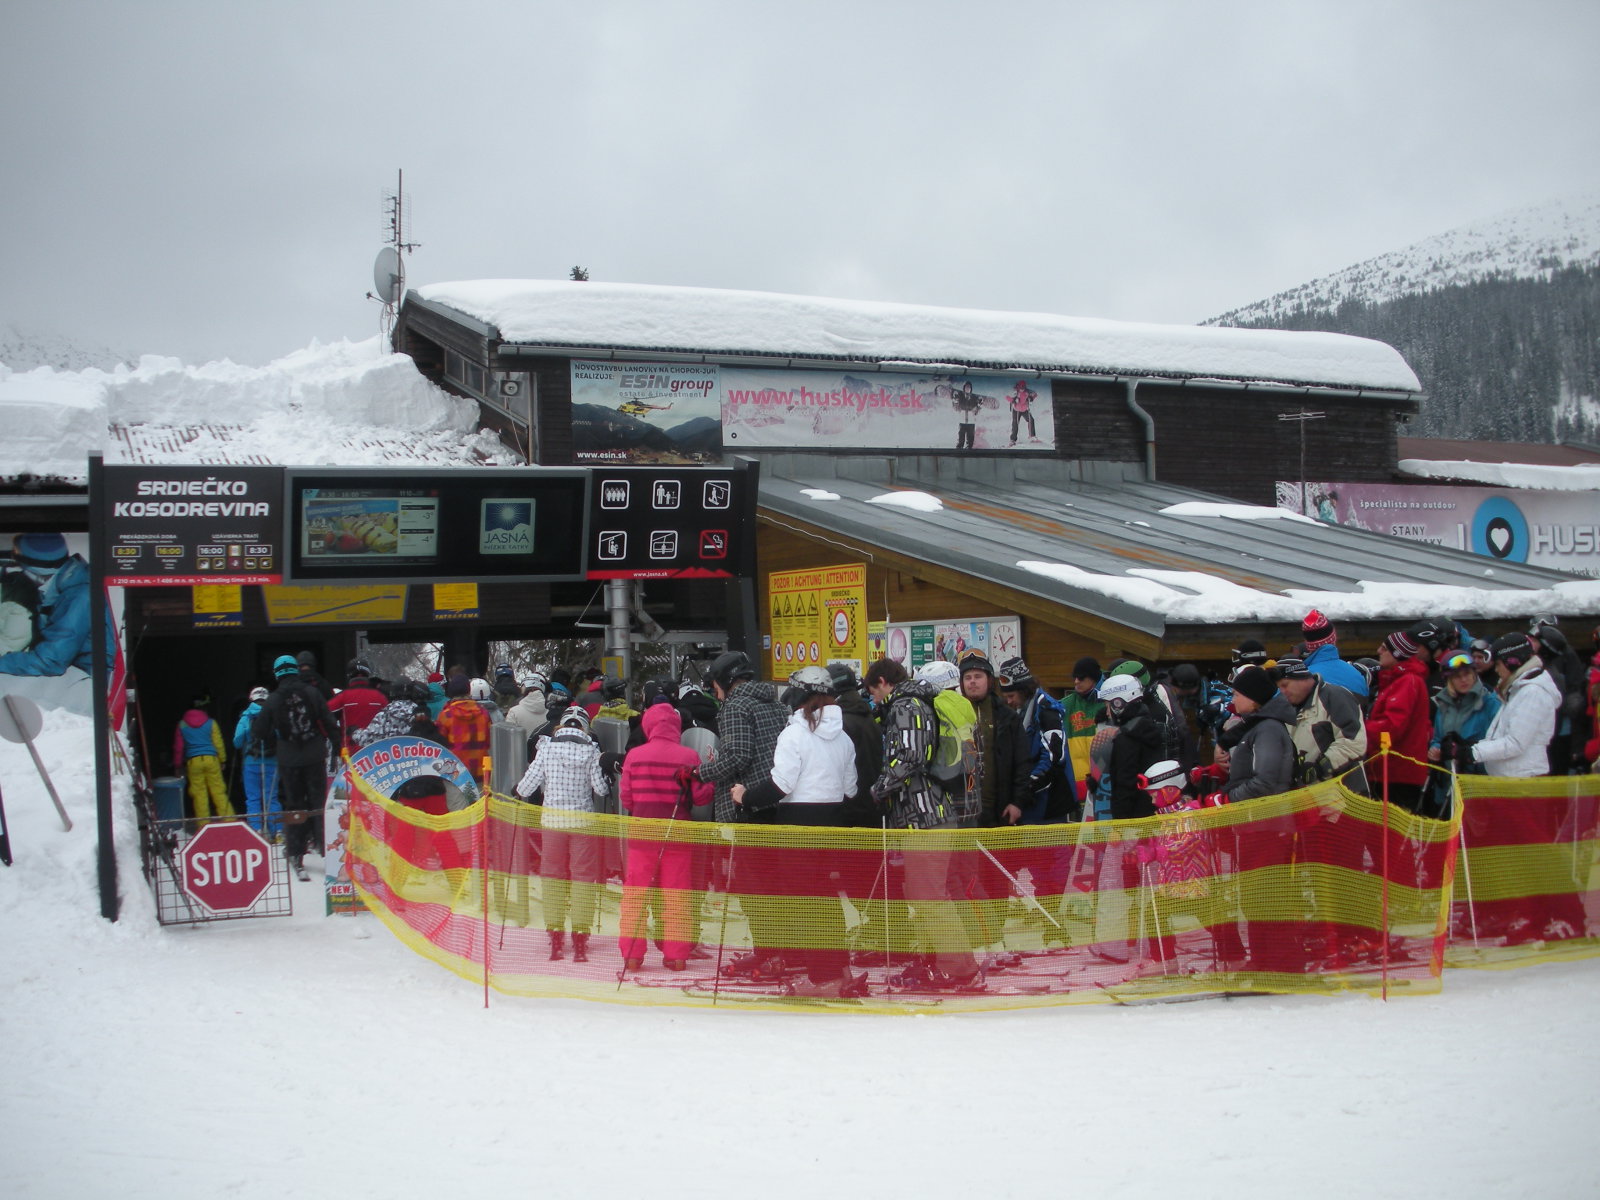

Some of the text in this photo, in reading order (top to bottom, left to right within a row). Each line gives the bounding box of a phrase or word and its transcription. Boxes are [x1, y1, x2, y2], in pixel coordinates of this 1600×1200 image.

[574, 363, 623, 372] NOVOSTAVBU
[575, 372, 615, 380] REALIZUJE:
[728, 386, 926, 411] www.huskysk.sk
[576, 451, 627, 459] www.esin.sk
[137, 476, 248, 496] SRDIEČKO
[113, 502, 270, 517] KOSODREVINA
[1423, 501, 1456, 509] outdoor
[484, 529, 530, 544] JASNÁ
[1392, 525, 1425, 536] STANY
[200, 547, 223, 555] 16:00
[773, 577, 791, 589] POZOR
[794, 574, 822, 587] ACHTUNG
[826, 570, 859, 585] ATTENTION
[373, 751, 391, 767] do
[391, 744, 402, 760] 6
[403, 741, 442, 759] rokov
[396, 759, 419, 773] years
[191, 848, 264, 887] STOP
[331, 885, 351, 895] NEW
